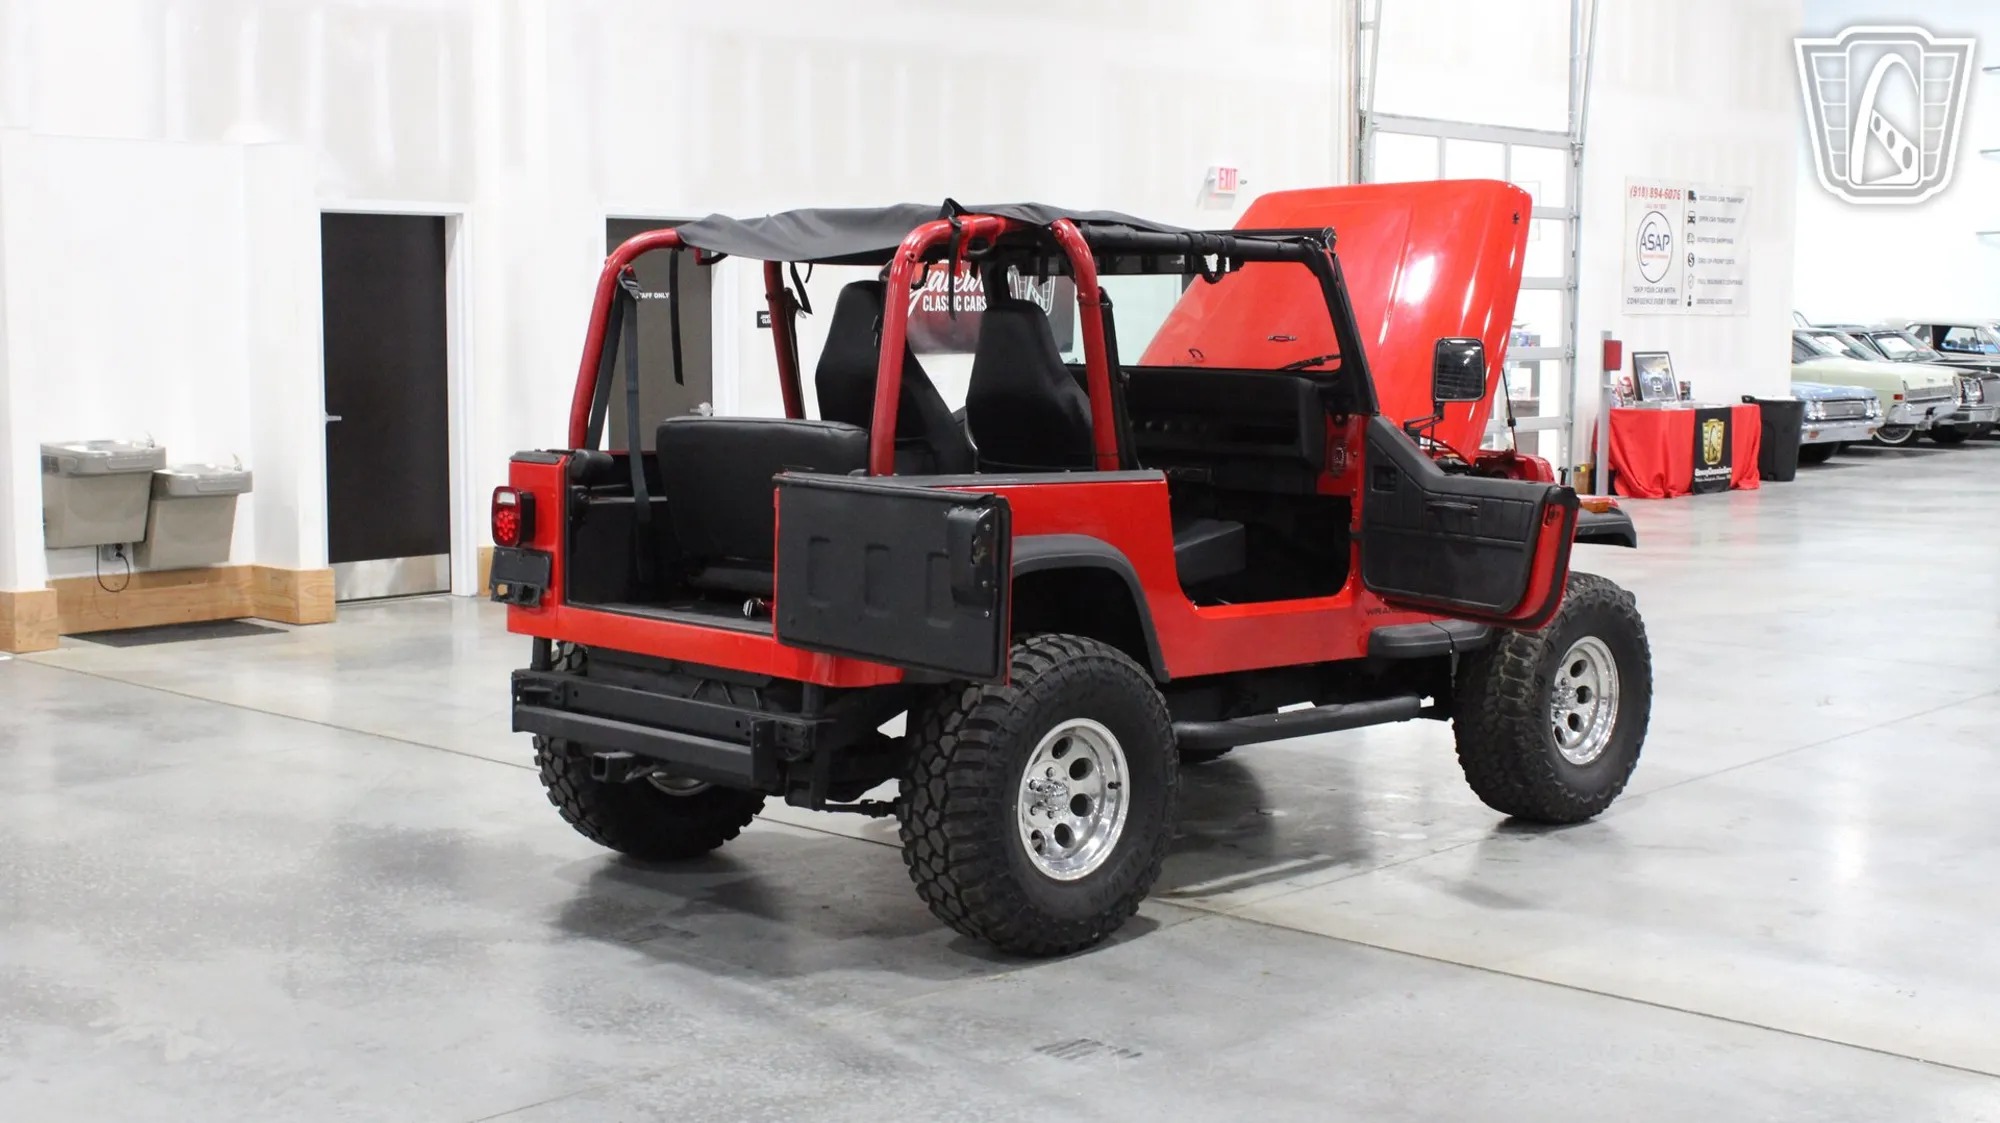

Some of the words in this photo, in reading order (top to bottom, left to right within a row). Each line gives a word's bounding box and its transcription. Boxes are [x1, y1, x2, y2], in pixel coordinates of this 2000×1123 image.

[1219, 167, 1238, 191] EXIT
[1640, 233, 1670, 251] ASAP
[653, 291, 670, 299] ONLY
[922, 295, 962, 311] CLASIC
[964, 295, 988, 312] CARS
